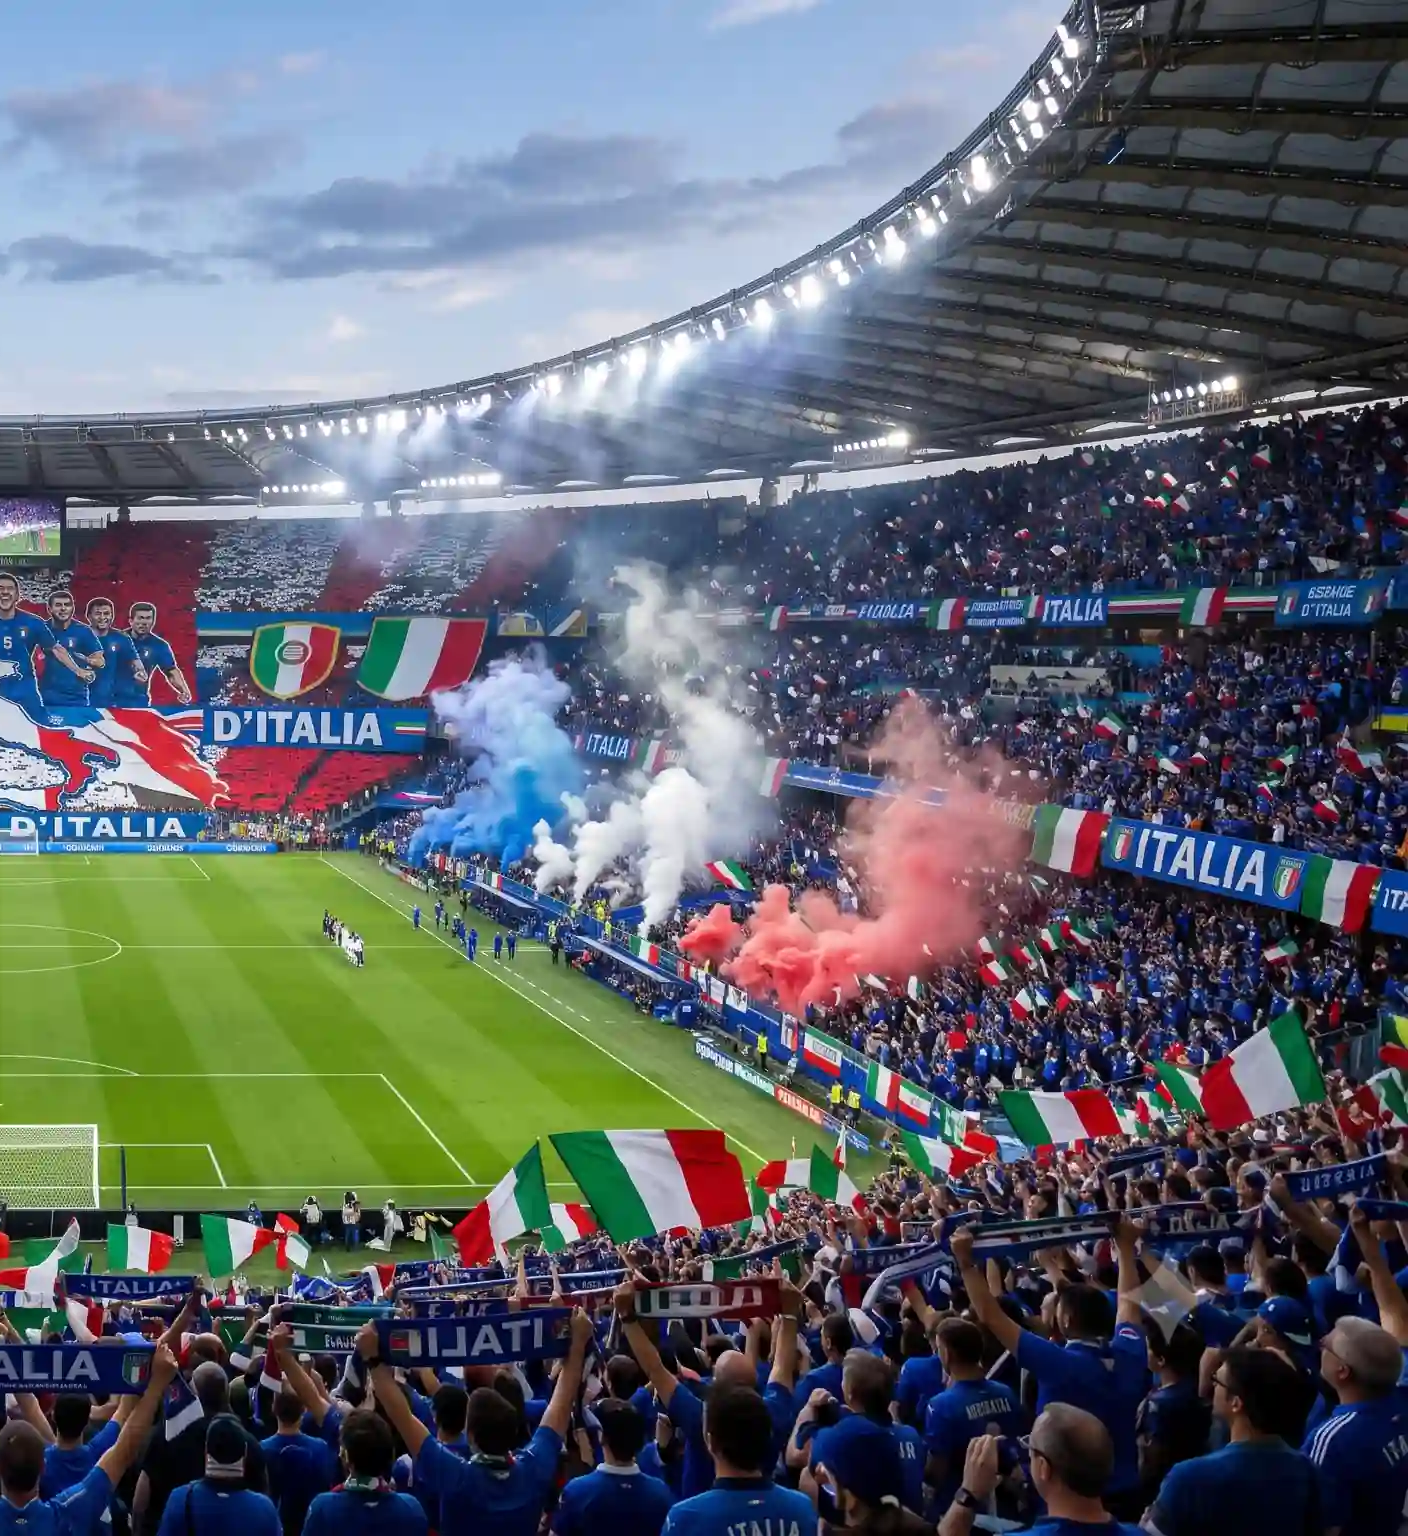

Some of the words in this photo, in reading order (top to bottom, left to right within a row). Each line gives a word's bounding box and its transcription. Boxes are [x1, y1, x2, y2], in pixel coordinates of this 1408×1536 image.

[1042, 598, 1104, 622] ITALIA
[3, 636, 13, 650] 5
[213, 710, 384, 746] D'ITALIA
[9, 816, 187, 838] D'ITALIA
[1135, 828, 1266, 897] ITALIA
